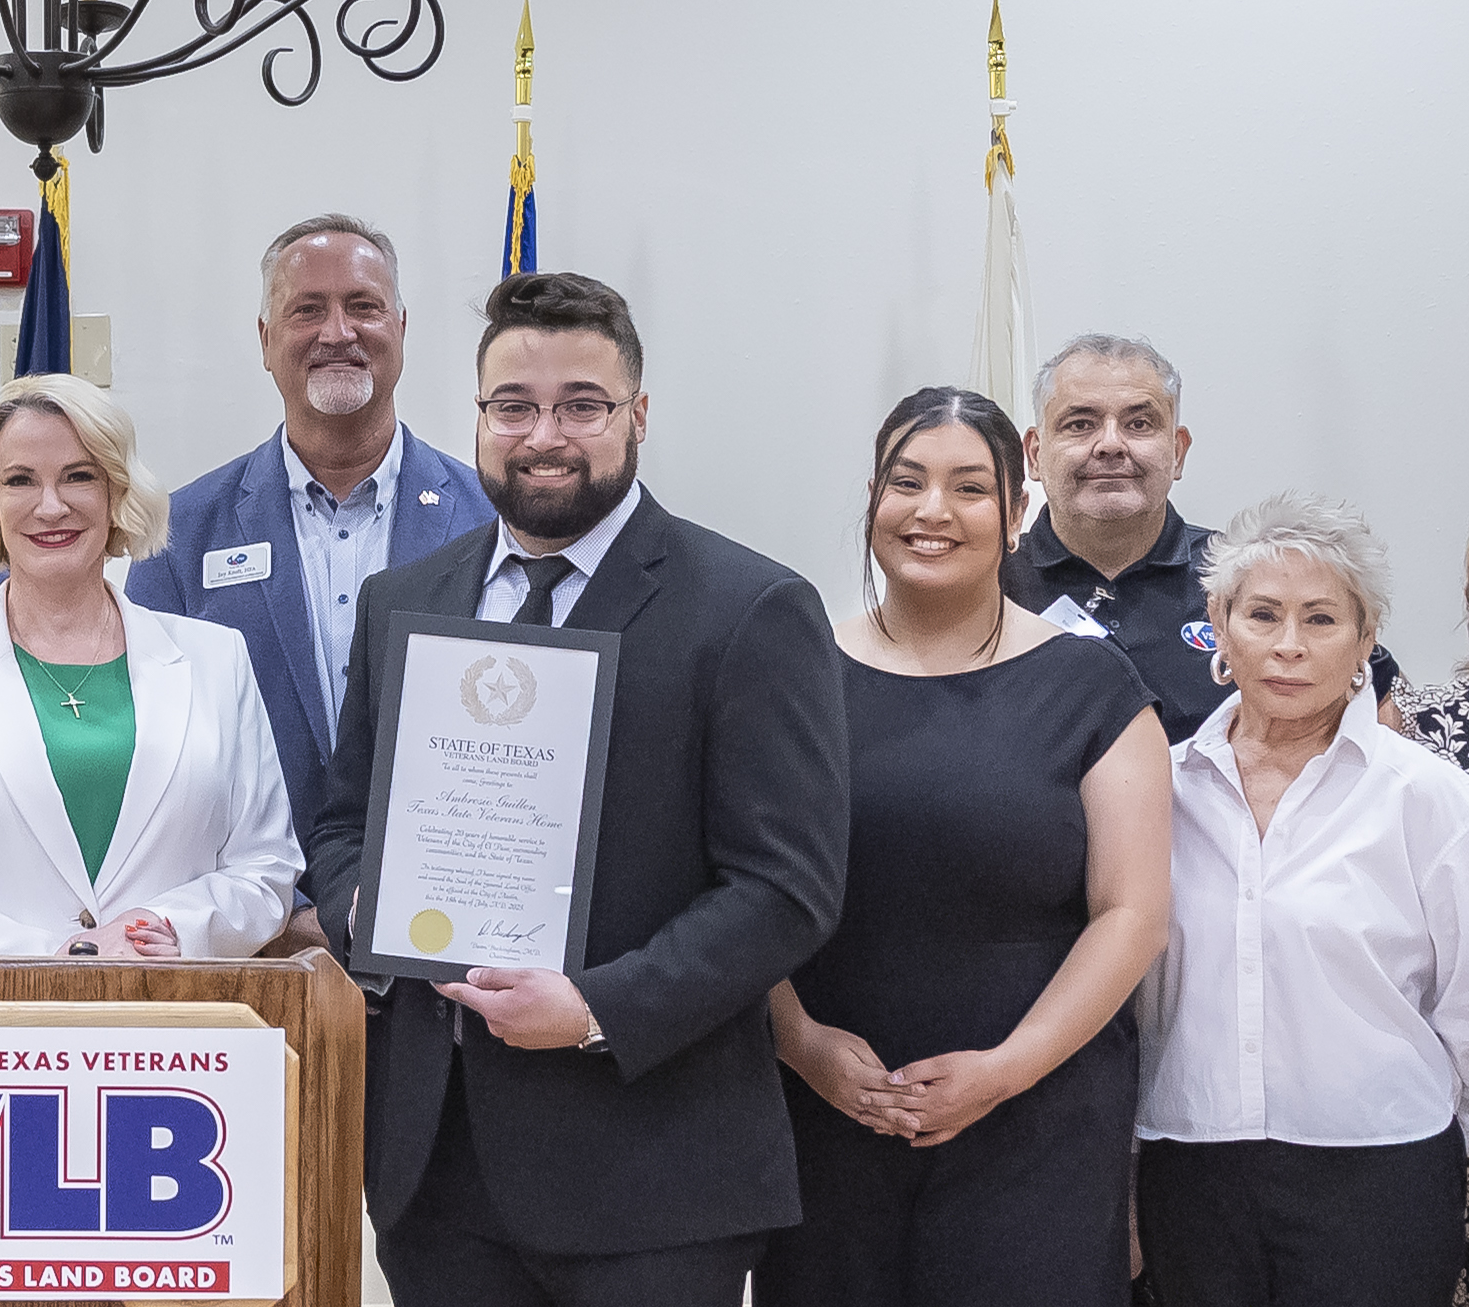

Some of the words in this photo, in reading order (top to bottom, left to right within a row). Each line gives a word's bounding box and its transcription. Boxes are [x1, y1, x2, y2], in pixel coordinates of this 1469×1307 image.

[1201, 632, 1215, 640] VS
[429, 736, 476, 753] STATE
[480, 742, 501, 754] OF
[503, 745, 555, 761] TEXAS
[444, 751, 485, 762] VETERANS
[487, 756, 509, 764] LAND
[510, 759, 538, 767] BOARD
[436, 789, 492, 806] Ambrosio
[496, 794, 537, 811] Guillen
[407, 799, 439, 816] Texas
[441, 805, 472, 819] State
[477, 807, 524, 825] Veterans
[526, 813, 563, 829] Home
[82, 1051, 229, 1072] VETERANS
[213, 1234, 233, 1246] TM
[24, 1265, 103, 1288] LAND
[115, 1265, 217, 1289] BOARD
